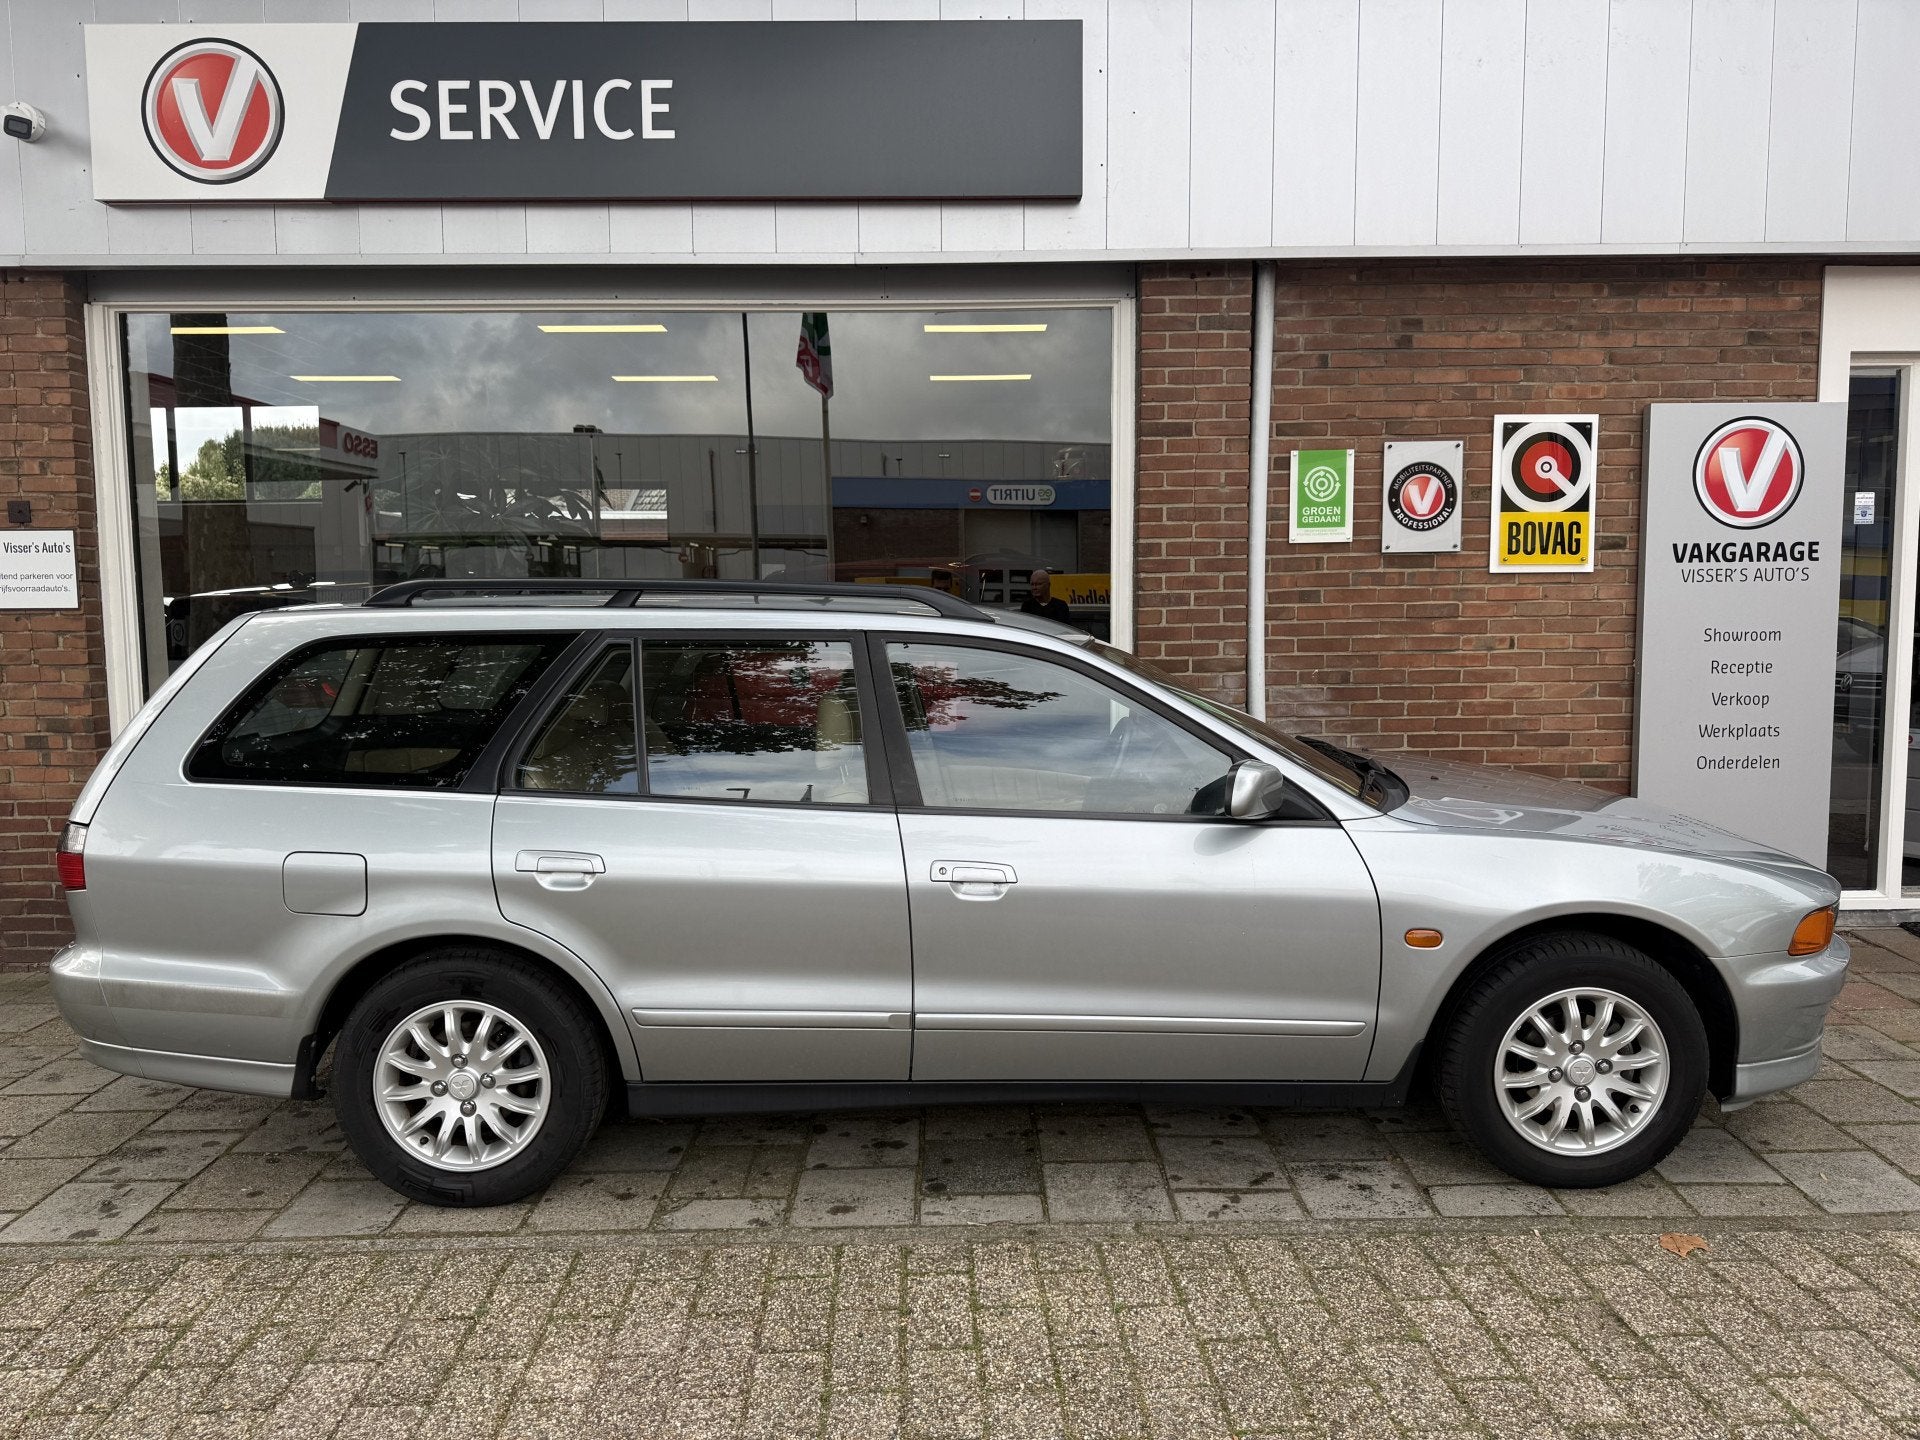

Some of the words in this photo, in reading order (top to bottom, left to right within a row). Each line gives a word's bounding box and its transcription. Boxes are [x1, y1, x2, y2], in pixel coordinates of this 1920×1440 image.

[389, 78, 676, 141] SERVICE
[1393, 464, 1453, 490] MOBILITEITSPARTNER
[1302, 506, 1341, 515] GROEN
[1393, 507, 1453, 529] PROFESSIONAL
[1302, 515, 1341, 523] GEDAAN!
[1507, 520, 1582, 556] BOVAG
[3, 541, 40, 553] Visser's
[42, 541, 71, 553] Auto's
[1672, 541, 1820, 563] VAKGARAGE
[20, 573, 54, 581] parkeren
[1703, 628, 1782, 642] Showroom
[1711, 660, 1773, 677] Receptie
[1711, 692, 1770, 709] Verkoop
[1699, 724, 1780, 740] Werkplaats
[1696, 755, 1780, 770] Onderdelen
